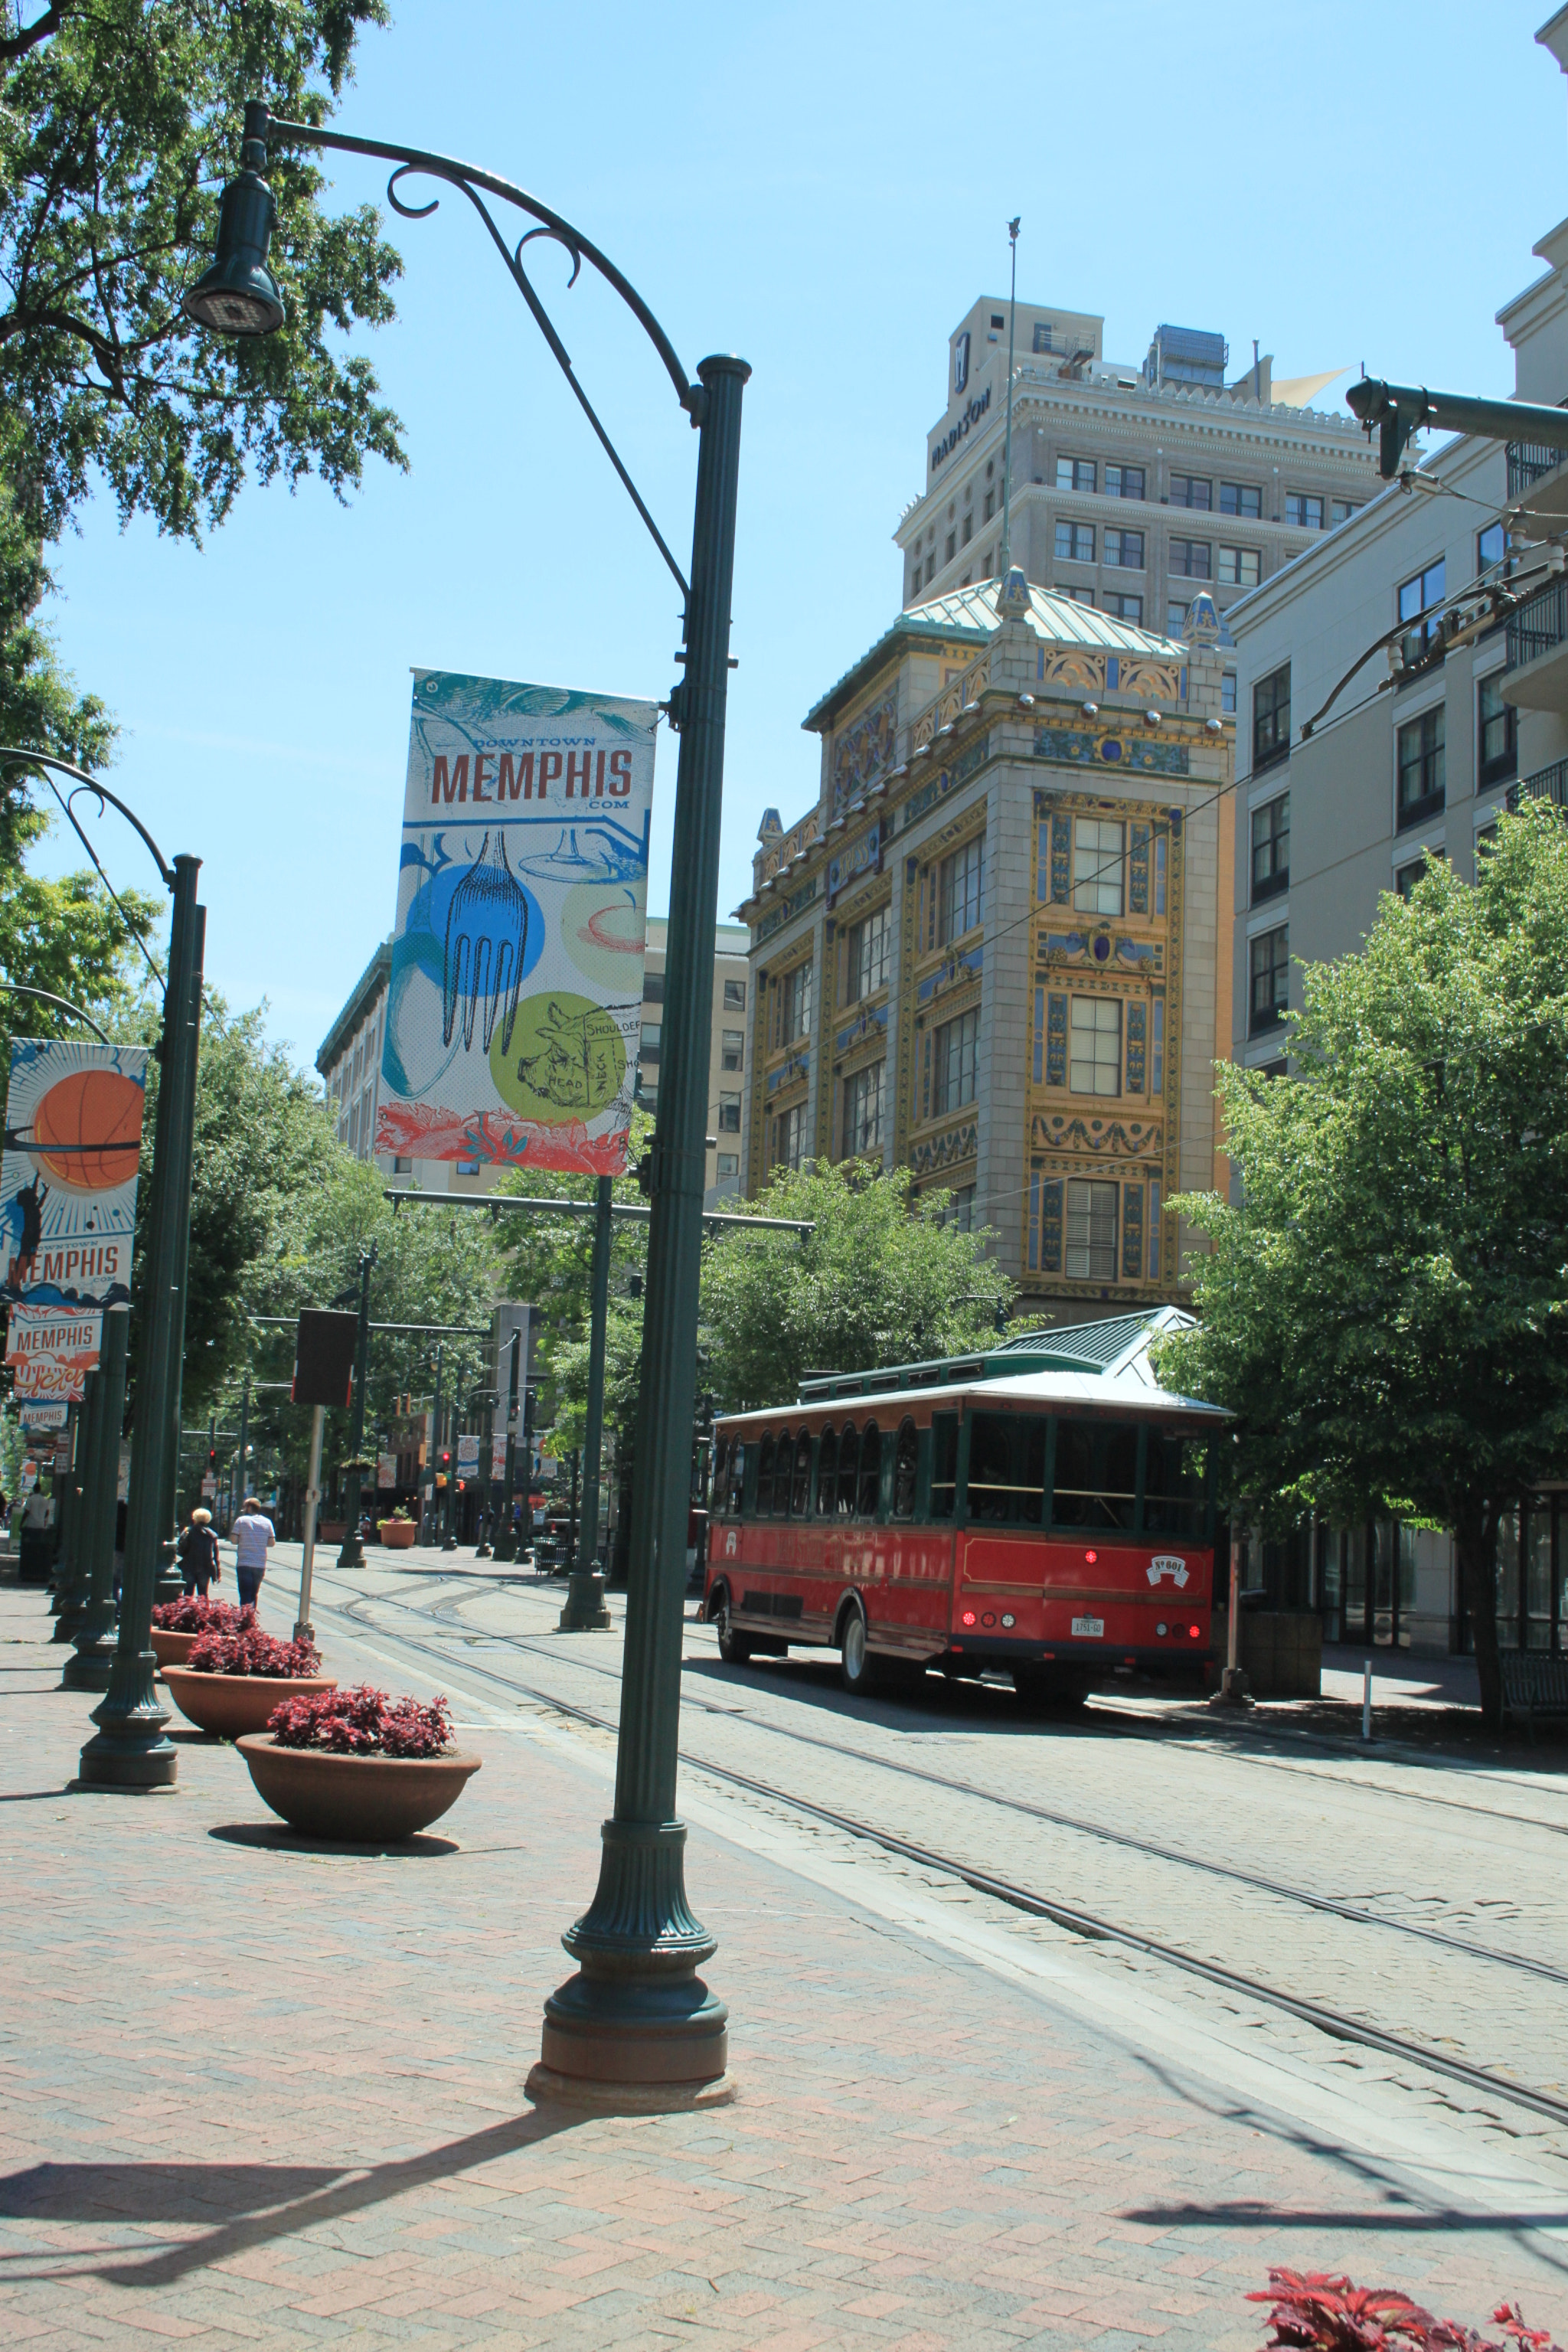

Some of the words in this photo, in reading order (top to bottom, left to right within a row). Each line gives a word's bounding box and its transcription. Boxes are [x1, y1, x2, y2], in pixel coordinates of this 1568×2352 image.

[932, 388, 991, 471] MADISON
[472, 737, 596, 748] DOWNTOWN
[431, 750, 632, 804] MEMPHIS
[589, 801, 629, 809] COM
[839, 836, 870, 886] KRESS
[549, 1076, 582, 1089] HEAD
[596, 1053, 607, 1089] NECK
[6, 1246, 119, 1287] MEMPHIS
[17, 1326, 93, 1351] MEMPHIS
[24, 1410, 62, 1423] MEMPHIS
[1165, 1560, 1181, 1572] 601
